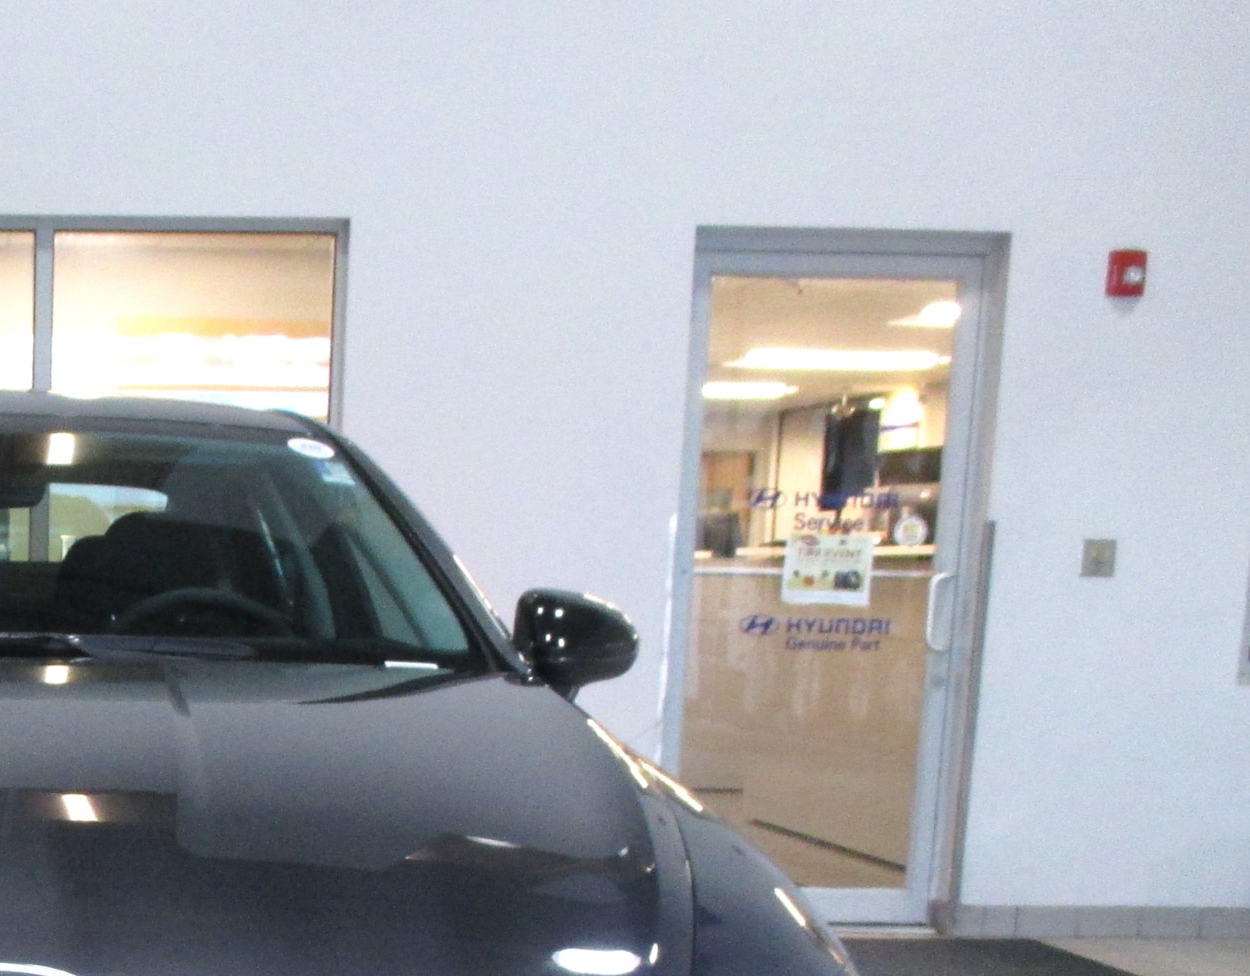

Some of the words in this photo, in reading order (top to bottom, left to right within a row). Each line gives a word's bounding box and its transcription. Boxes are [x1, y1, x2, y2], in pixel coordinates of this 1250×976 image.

[795, 512, 862, 530] Service
[787, 617, 891, 635] HYUNDAI
[786, 636, 847, 650] Genuine
[851, 636, 880, 650] Part
